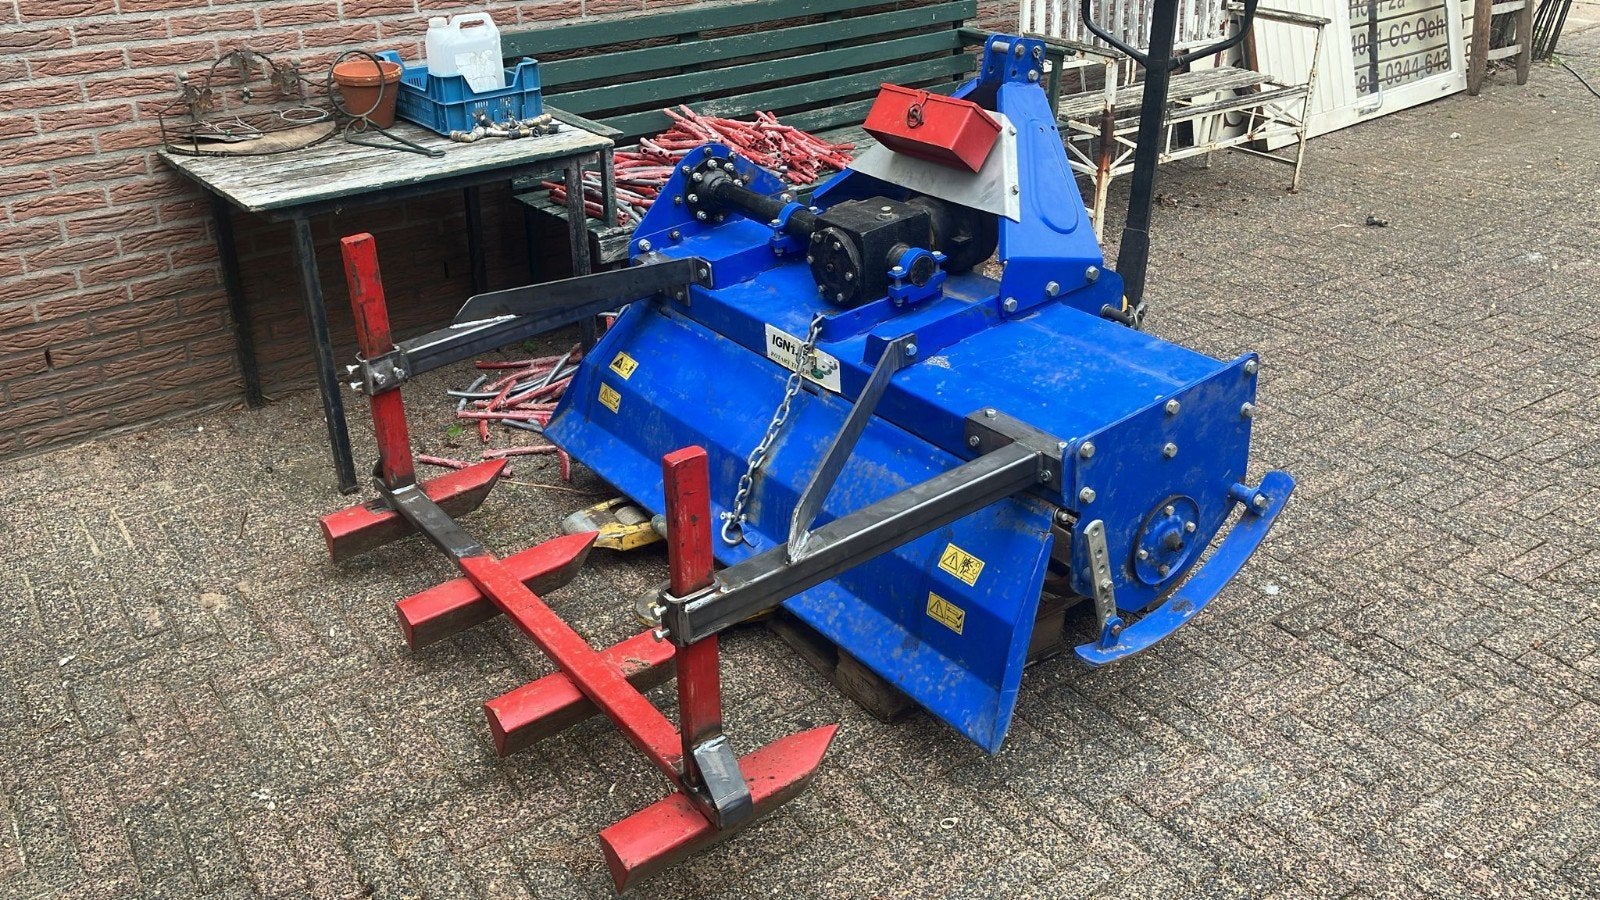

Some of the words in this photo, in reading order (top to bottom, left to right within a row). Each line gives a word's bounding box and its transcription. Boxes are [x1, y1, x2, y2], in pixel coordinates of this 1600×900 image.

[1352, 28, 1382, 57] 401
[1390, 21, 1410, 47] CC
[1417, 15, 1444, 40] Och
[1386, 57, 1418, 85] 0344
[1425, 49, 1449, 74] 643
